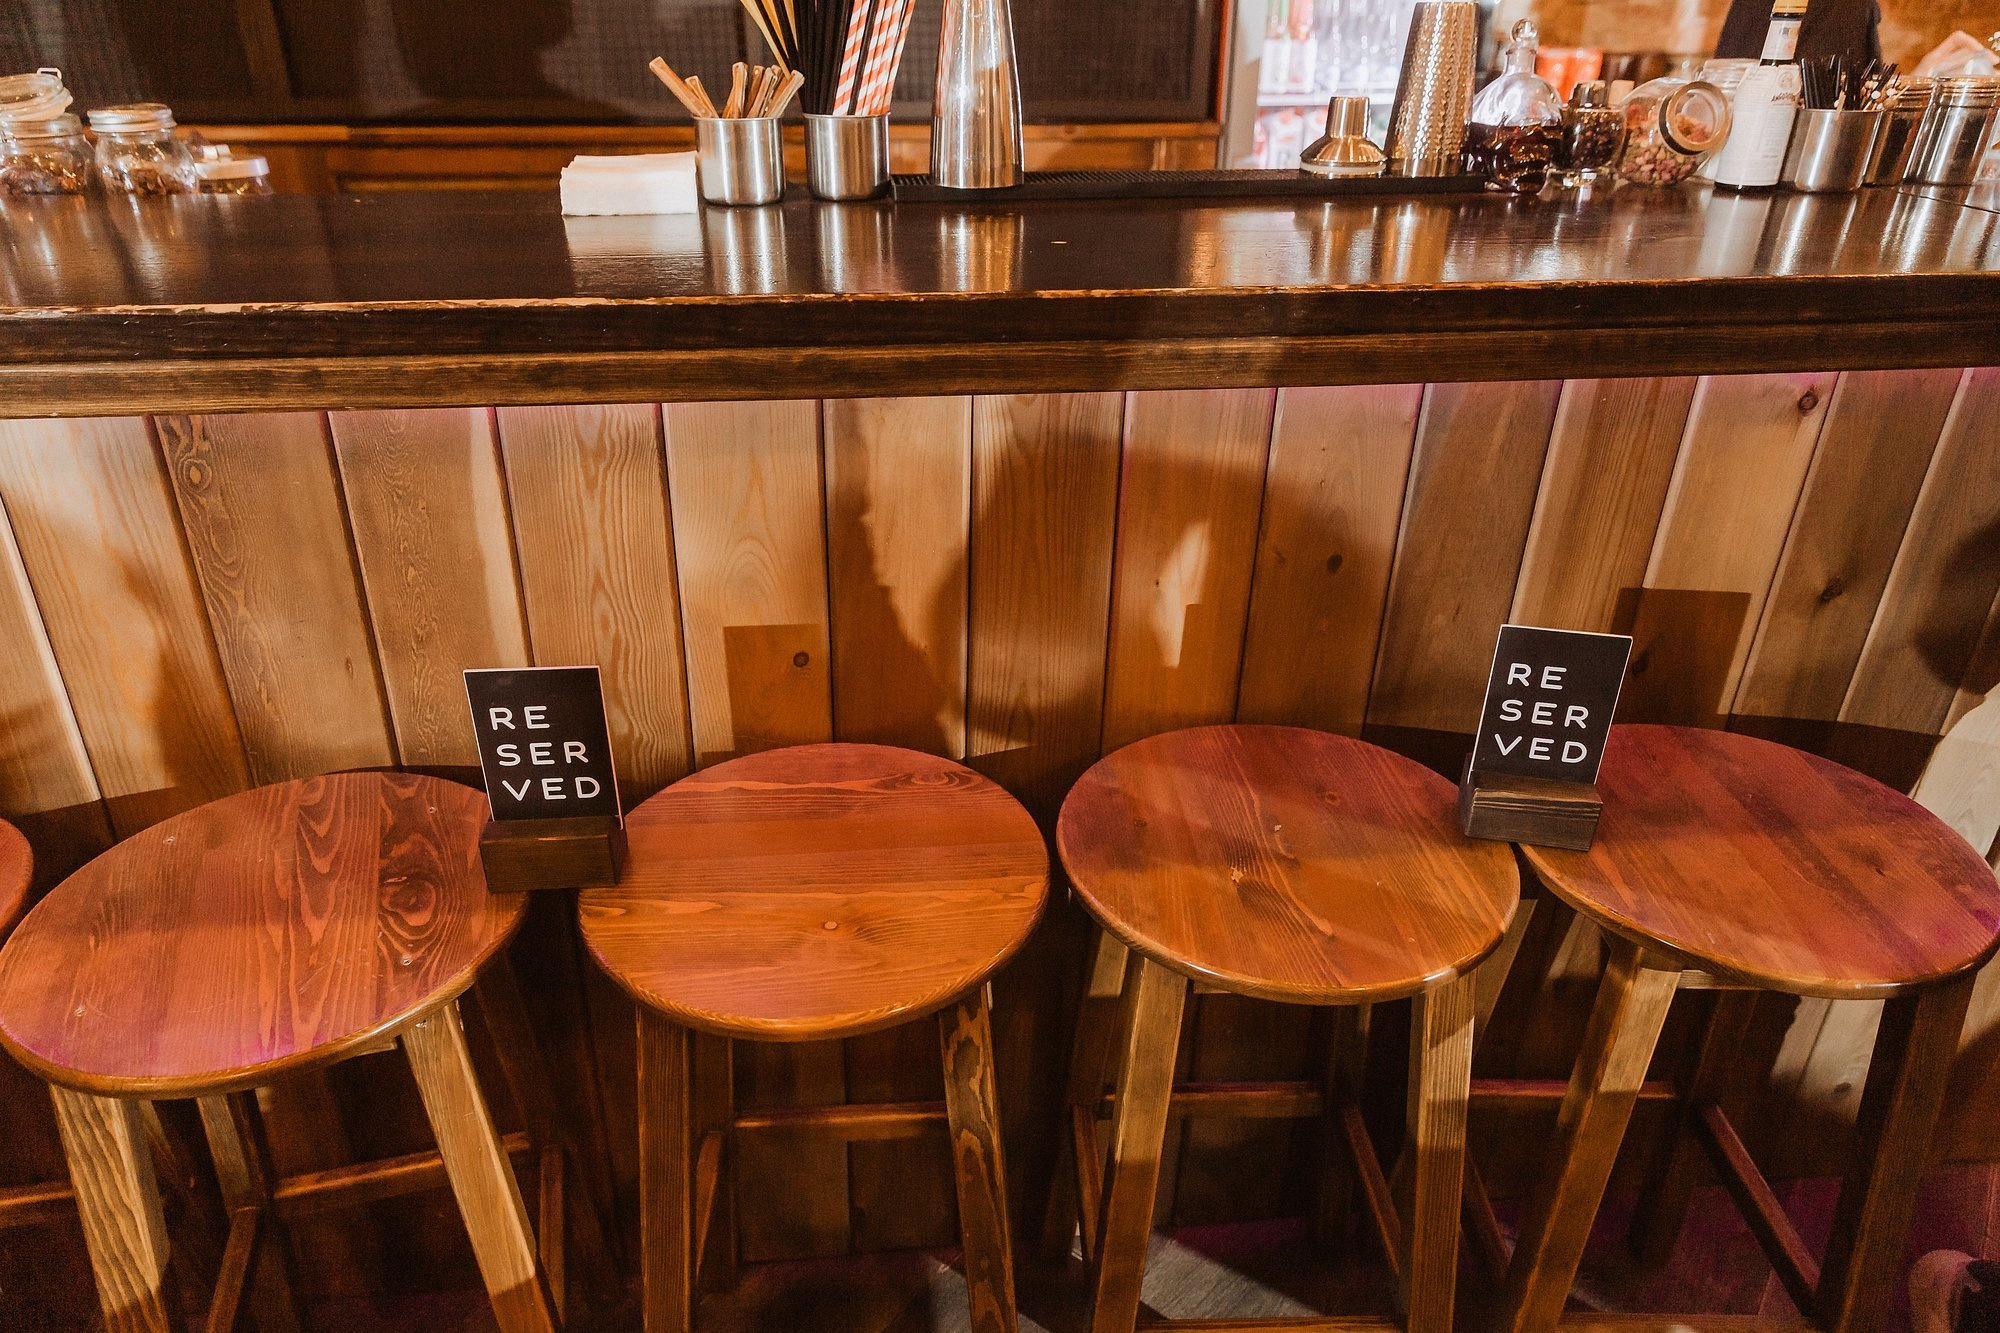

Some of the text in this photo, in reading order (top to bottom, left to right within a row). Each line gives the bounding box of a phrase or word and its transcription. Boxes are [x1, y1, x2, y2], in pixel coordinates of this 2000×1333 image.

[1507, 663, 1568, 690] RE
[489, 706, 551, 730] RE
[1499, 700, 1589, 728] SER
[497, 742, 589, 766] SER
[1495, 734, 1588, 763] VED
[502, 777, 601, 801] VED
